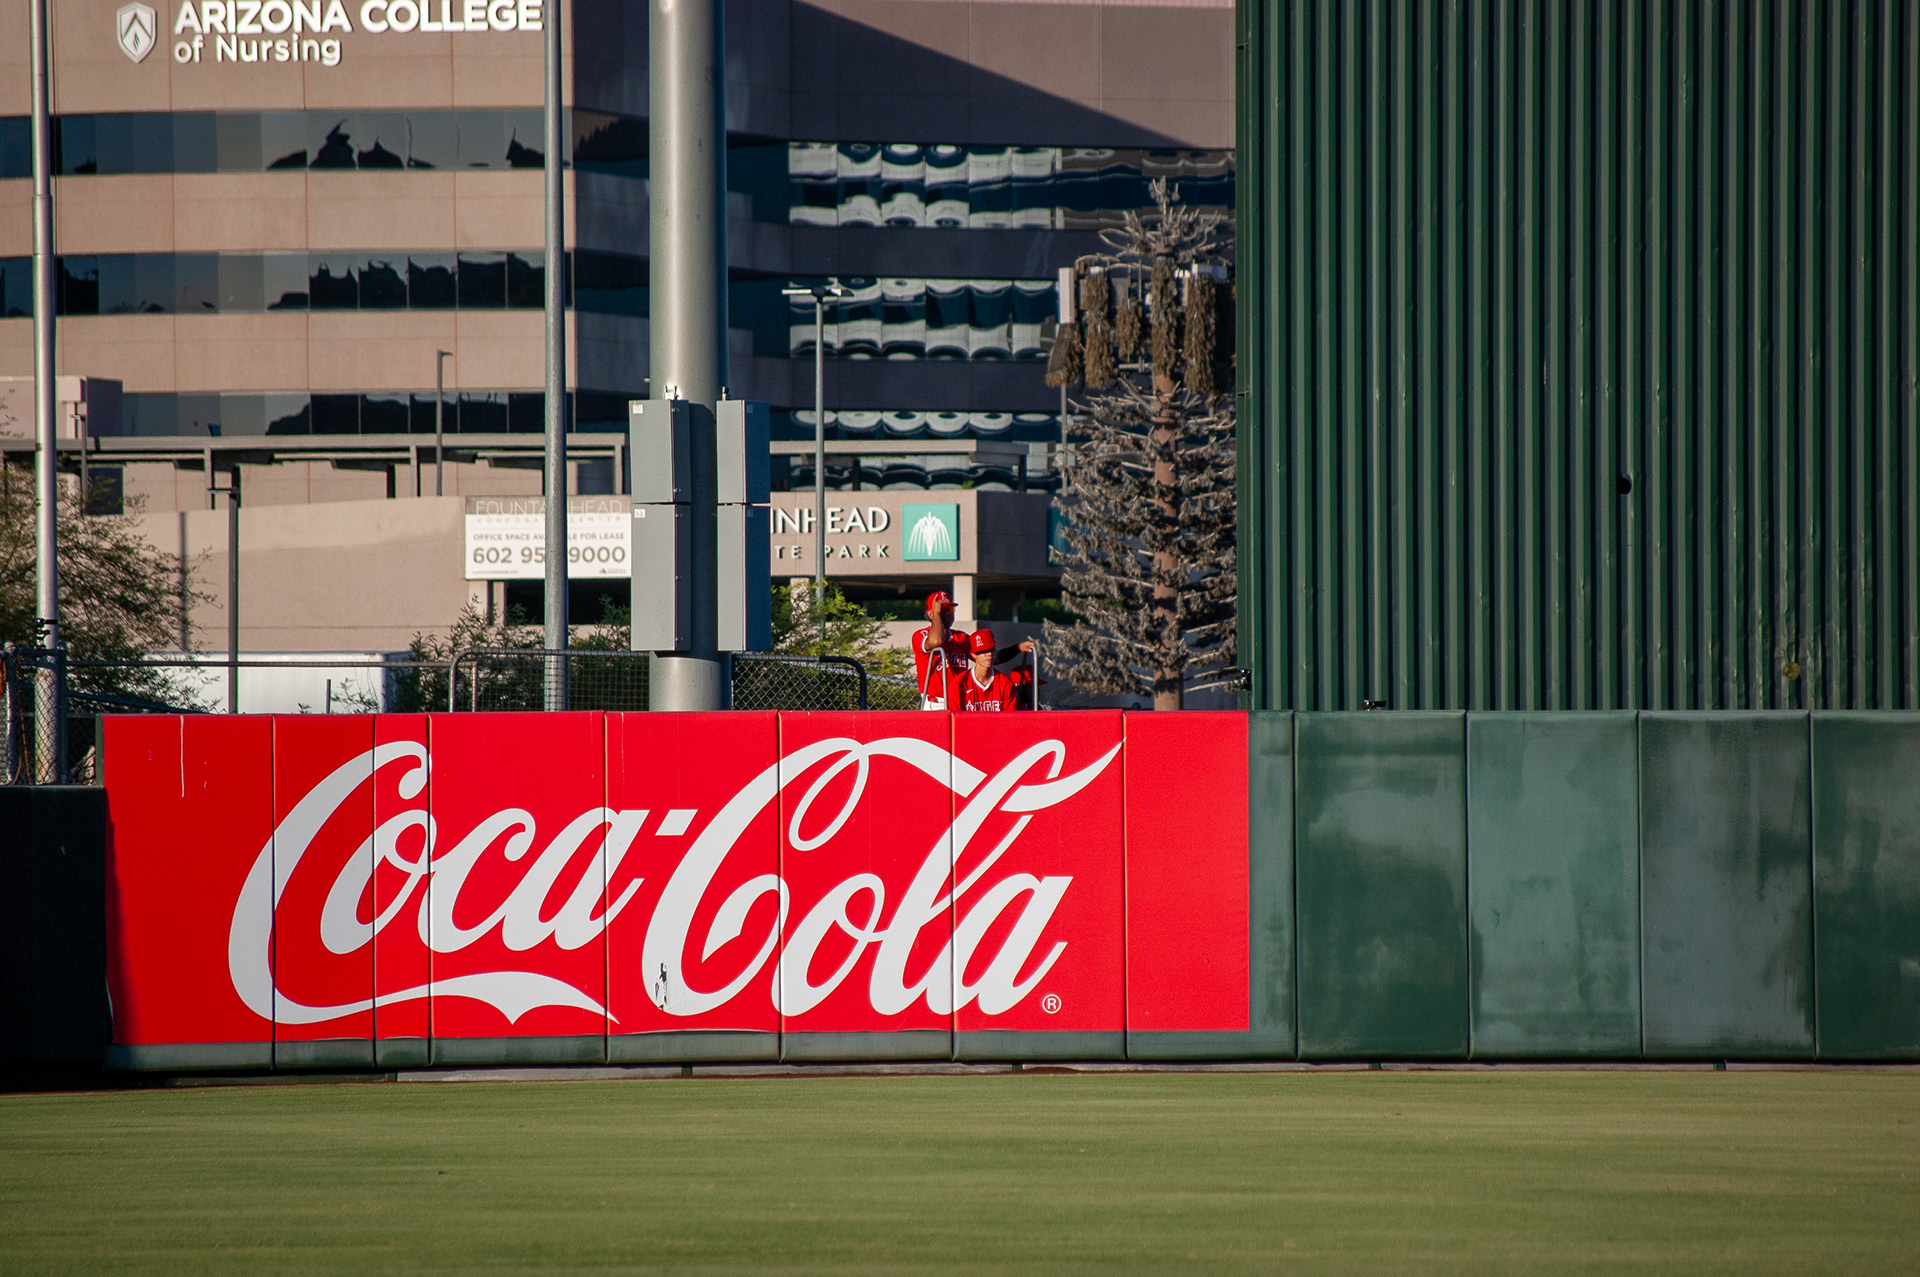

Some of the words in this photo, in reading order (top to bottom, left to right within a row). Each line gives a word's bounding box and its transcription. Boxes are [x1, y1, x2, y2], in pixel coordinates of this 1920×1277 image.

[174, 0, 352, 34] ARIZONA
[360, 0, 543, 31] COLLEGE
[174, 33, 205, 63] of
[216, 31, 342, 66] Nursing
[475, 500, 623, 515] FOUNTHEAD
[473, 533, 502, 541] OFFICE
[505, 533, 530, 541] SPACE
[473, 546, 512, 563] 602
[569, 546, 625, 562] 9000
[825, 544, 889, 558] PARK
[227, 736, 1124, 1025] Coca-Cola
